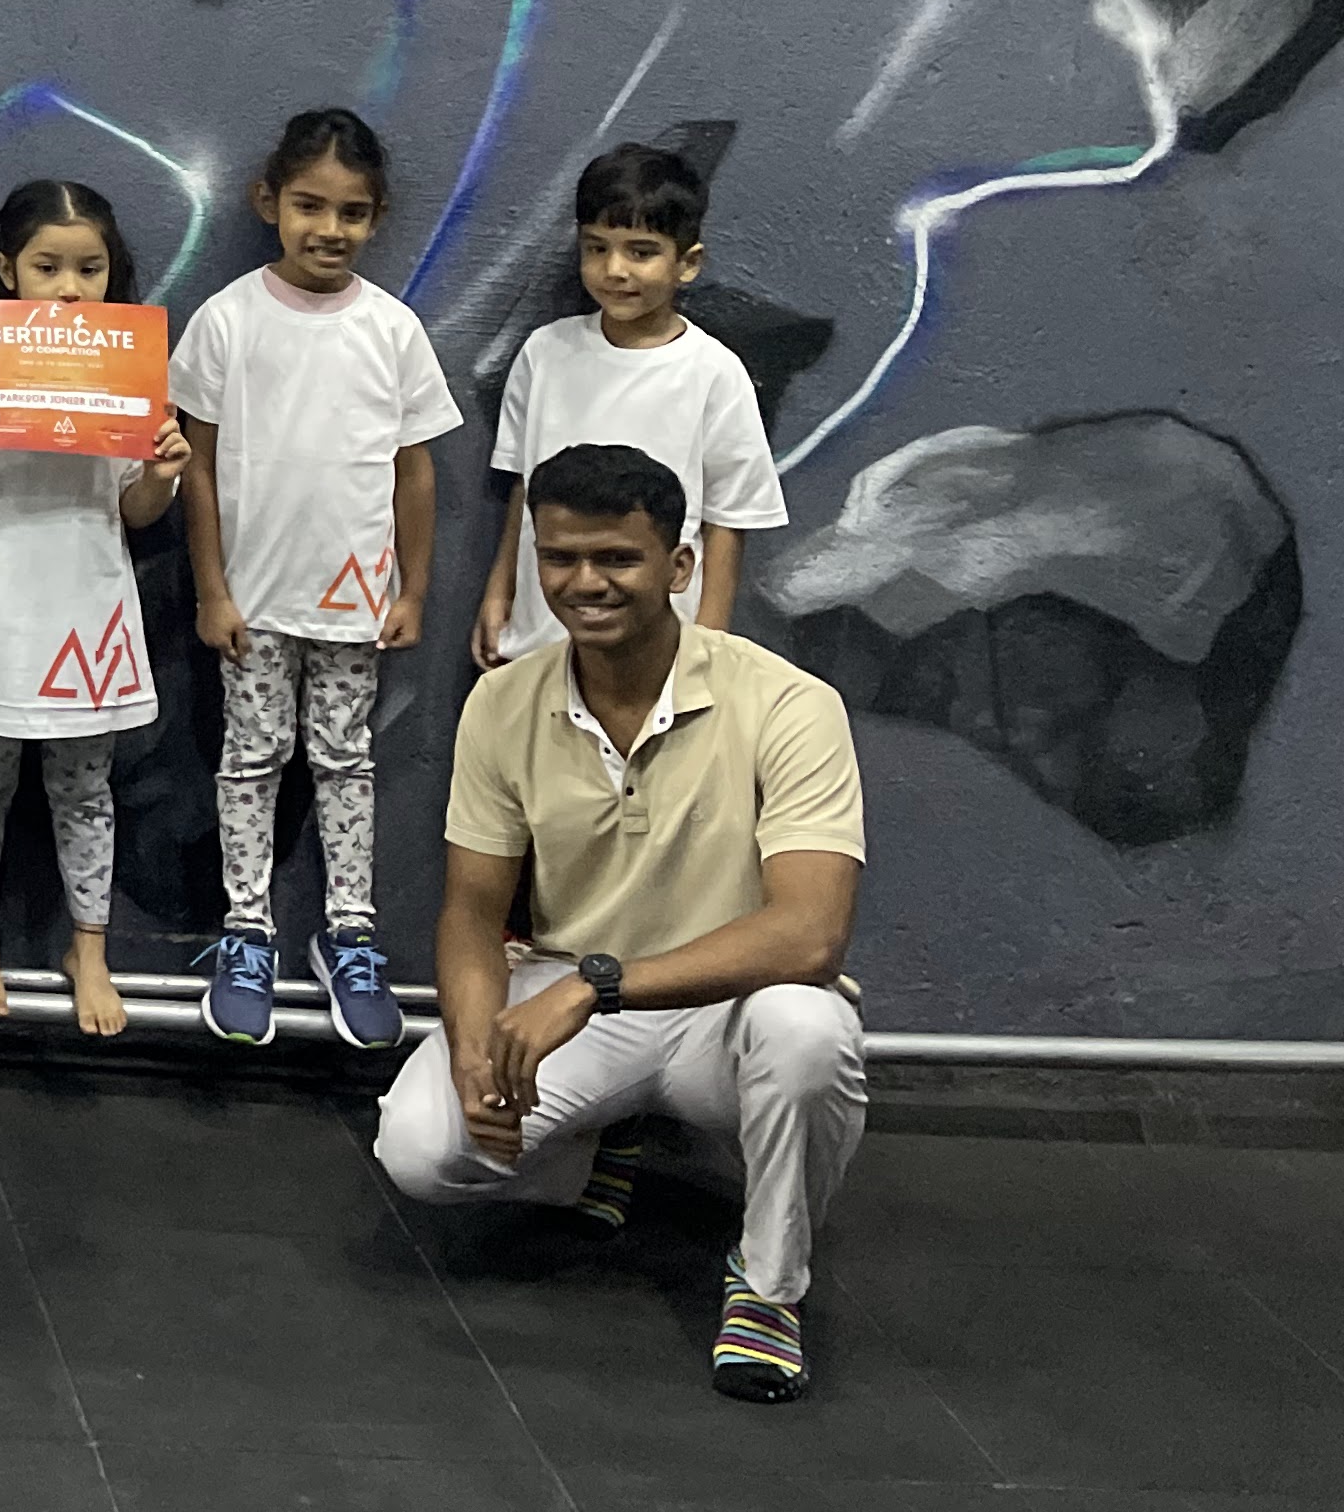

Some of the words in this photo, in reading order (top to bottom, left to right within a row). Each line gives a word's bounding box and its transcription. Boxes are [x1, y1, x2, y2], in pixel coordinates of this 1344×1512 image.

[21, 345, 34, 353] OF
[36, 346, 100, 356] COMPLETION
[89, 398, 116, 408] LEVEL
